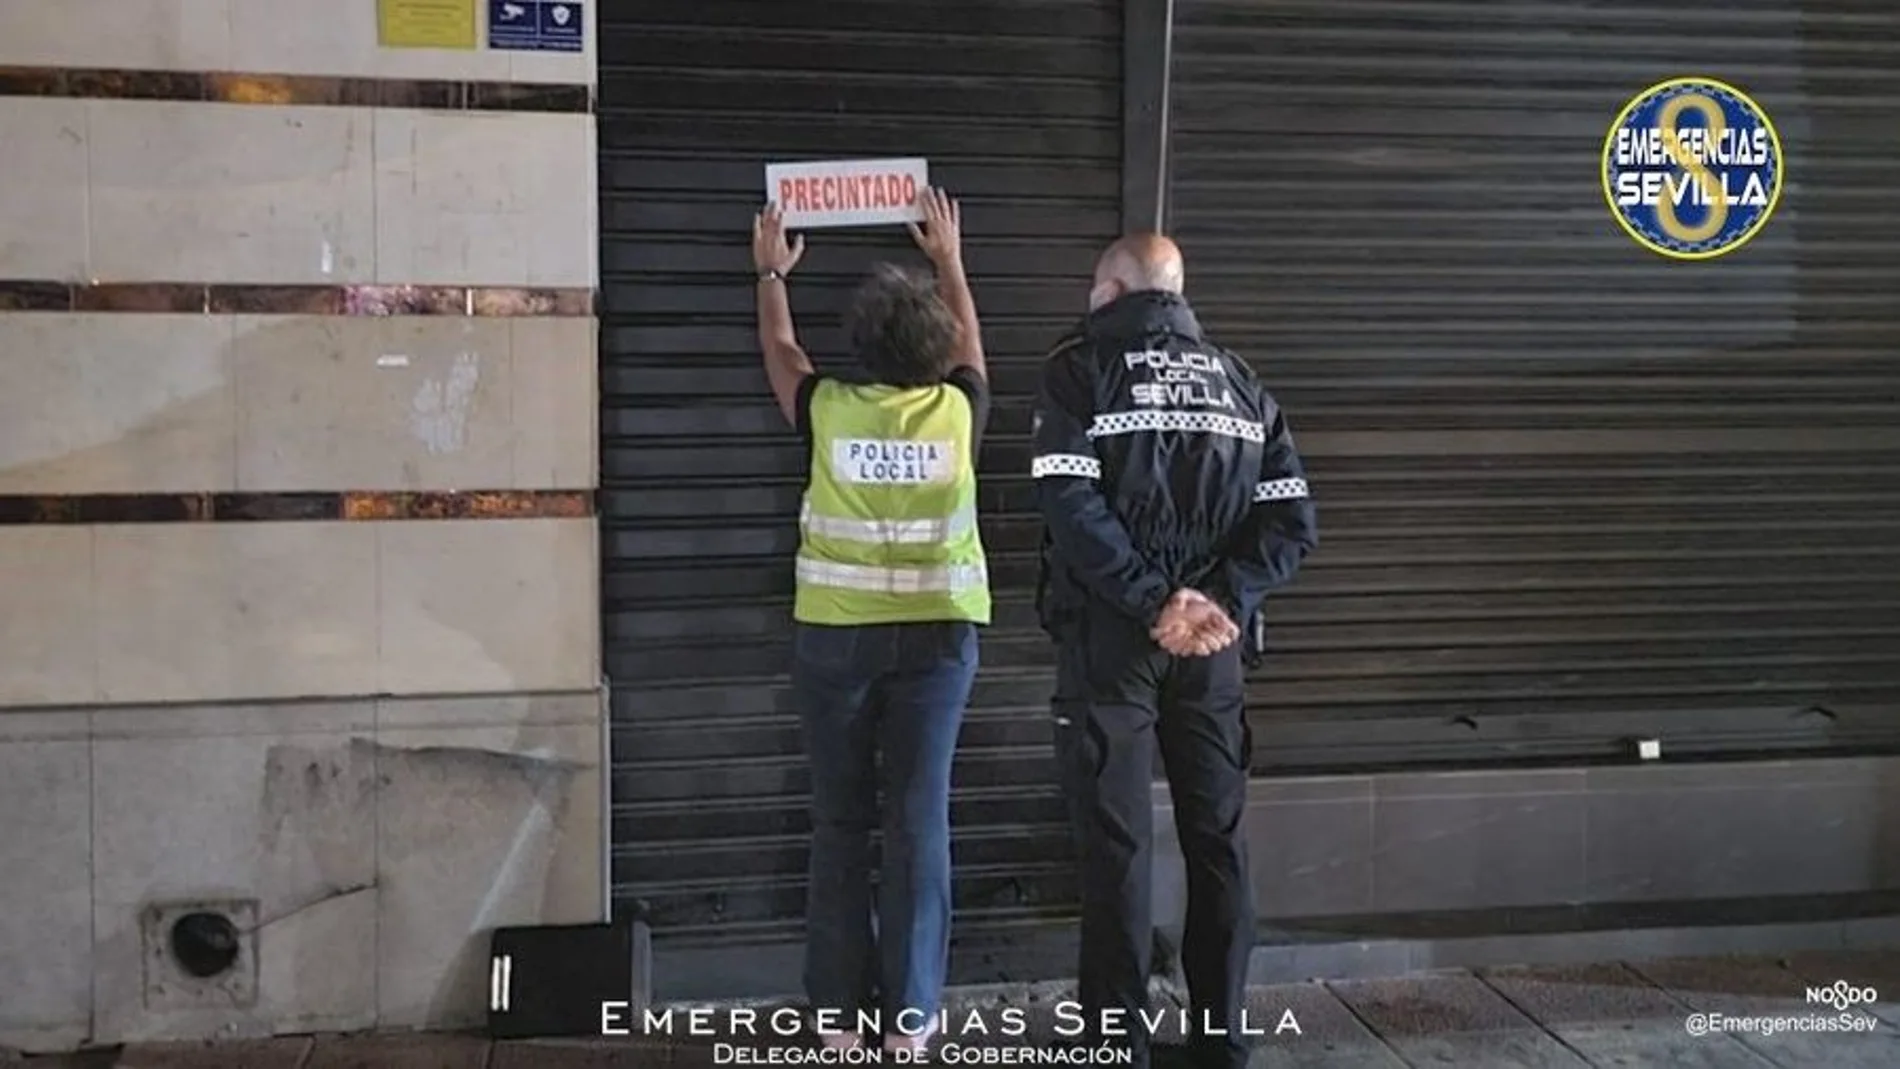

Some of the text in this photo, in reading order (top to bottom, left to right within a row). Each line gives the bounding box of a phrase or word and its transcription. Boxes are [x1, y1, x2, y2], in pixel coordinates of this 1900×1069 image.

[778, 174, 917, 211] PRECINTADO
[1124, 349, 1227, 376] POLICIA
[1130, 382, 1236, 410] SEVILLA
[850, 443, 938, 461] POLICIA
[859, 463, 927, 479] LOCAL
